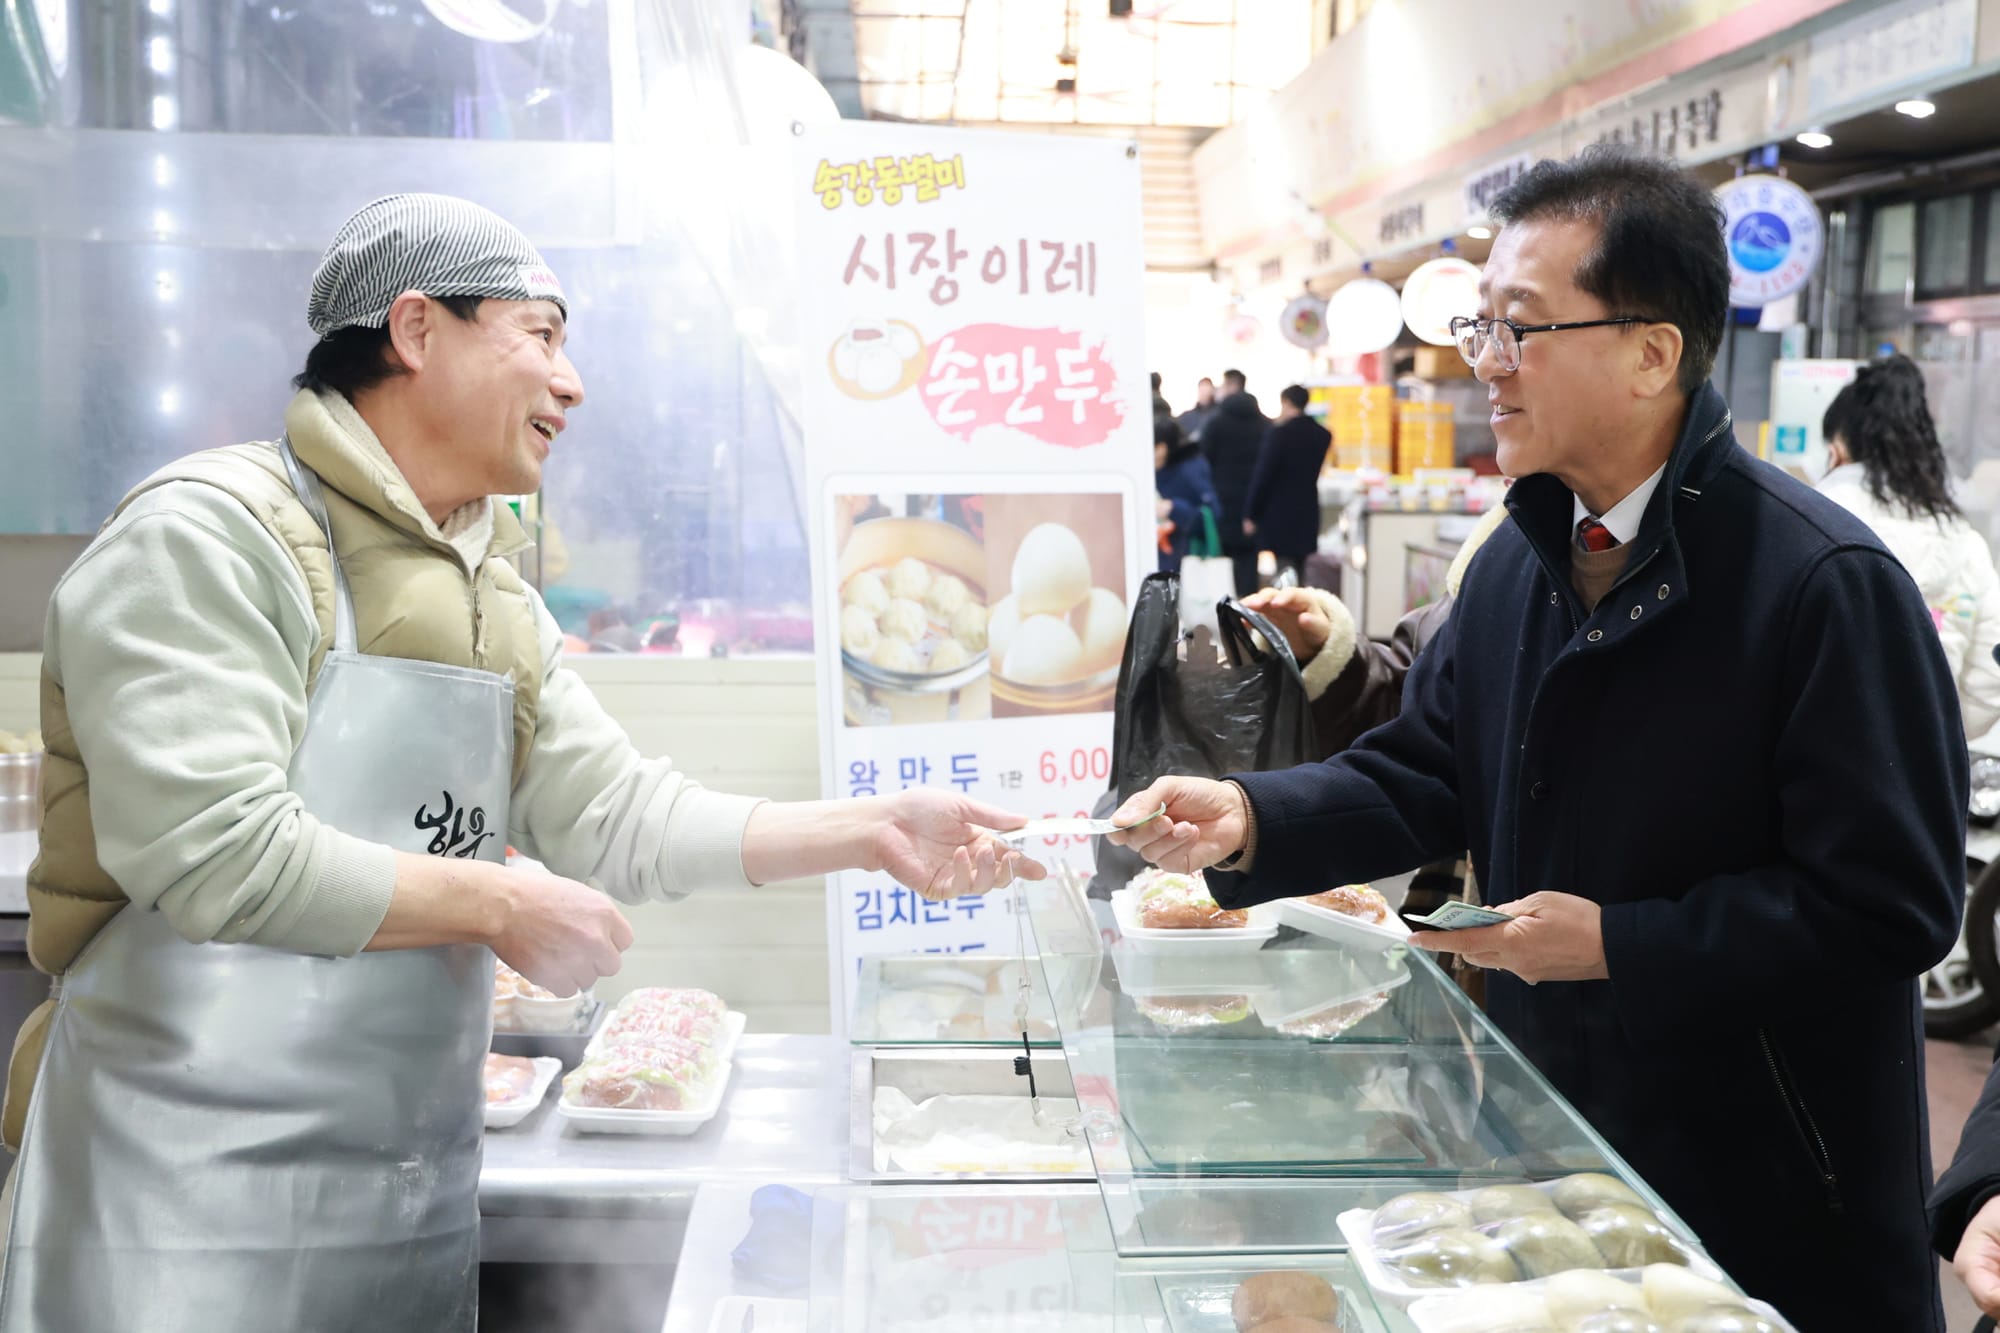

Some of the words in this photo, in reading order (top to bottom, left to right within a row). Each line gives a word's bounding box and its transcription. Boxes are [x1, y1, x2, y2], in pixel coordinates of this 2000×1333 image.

[813, 152, 966, 210] 송강동별미
[843, 228, 1097, 306] 시장이레
[925, 337, 1099, 426] 손만두
[1039, 747, 1110, 787] 6,00
